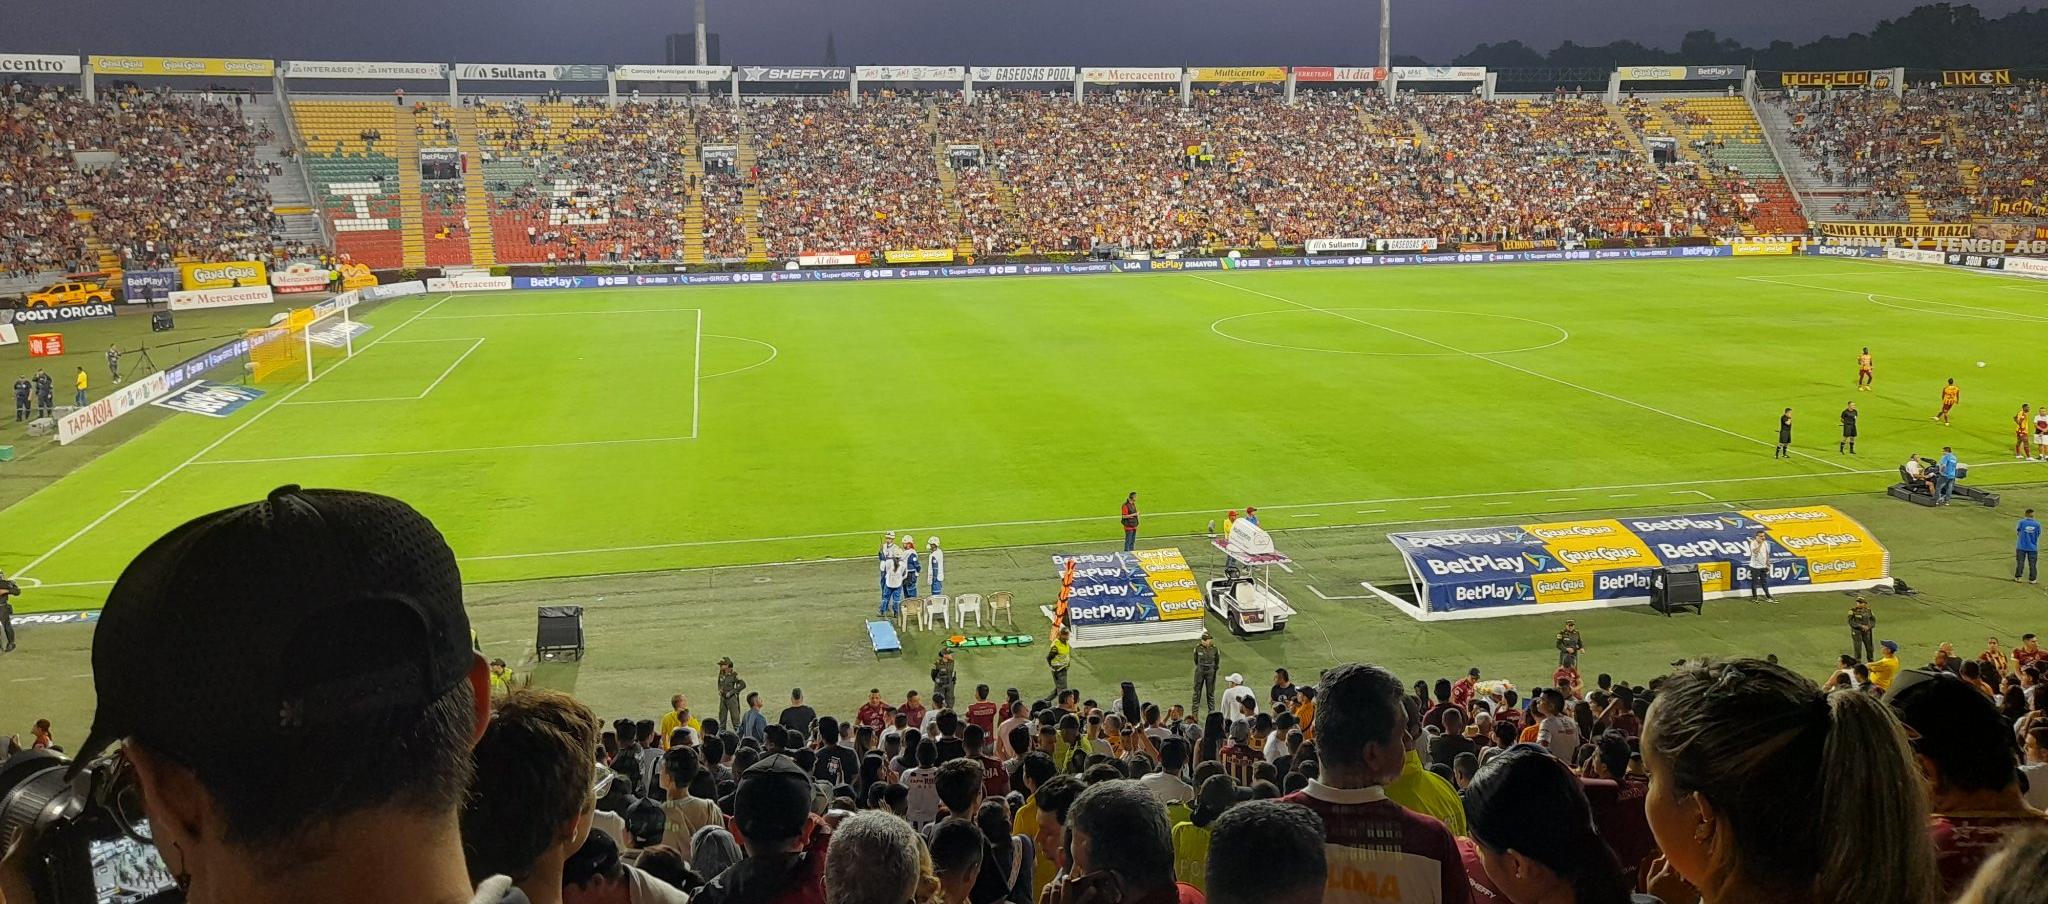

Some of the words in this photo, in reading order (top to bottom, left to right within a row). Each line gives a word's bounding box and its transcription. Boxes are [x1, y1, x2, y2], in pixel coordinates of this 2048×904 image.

[0, 59, 64, 73] centro
[491, 67, 546, 79] Sullanta
[768, 69, 846, 79] SHEFFY.CO
[996, 68, 1045, 80] GASEOSAS
[1047, 68, 1071, 80] POOL
[1108, 70, 1176, 80] Mercacentro
[1214, 69, 1265, 77] Multicentro
[1337, 69, 1350, 79] Al
[1353, 69, 1370, 80] día
[1784, 72, 1866, 84] TOPACIO
[421, 153, 448, 161] BetPlay
[1822, 224, 1857, 236] CANTA
[1859, 225, 1871, 236] EL
[1877, 225, 1902, 237] ALMA
[1905, 225, 1918, 236] DE
[1922, 226, 1934, 237] MI
[1938, 225, 1969, 237] RAZA
[1391, 240, 1419, 249] GASEOSAS
[1935, 239, 2005, 253] TENGO
[2013, 240, 2048, 253] AG
[1683, 247, 1713, 256] BetPlay
[1819, 246, 1857, 256] BetPlay
[1151, 260, 1184, 270] BetPlay
[1965, 256, 1982, 266] SODA
[2022, 262, 2048, 271] Mercac
[127, 277, 163, 287] BetPlay
[278, 274, 327, 283] Mercacentro
[450, 280, 507, 288] Mercacentro
[530, 277, 573, 288] BetPlay
[197, 291, 268, 304] Mercacentro
[16, 307, 58, 322] GOLTY
[61, 304, 113, 318] ORIGEN
[1633, 515, 1724, 532] BetPlay
[1408, 532, 1503, 549] BetPlay
[1658, 540, 1752, 559] BetPlay
[1427, 555, 1525, 576] BetPlay
[1737, 564, 1791, 582] Belay
[1599, 572, 1651, 590] BetPlay
[1068, 583, 1129, 597] BetPlay
[1456, 586, 1514, 602] BetPlay
[1070, 603, 1135, 619] BetPlay
[1328, 863, 1402, 902] LIMA
